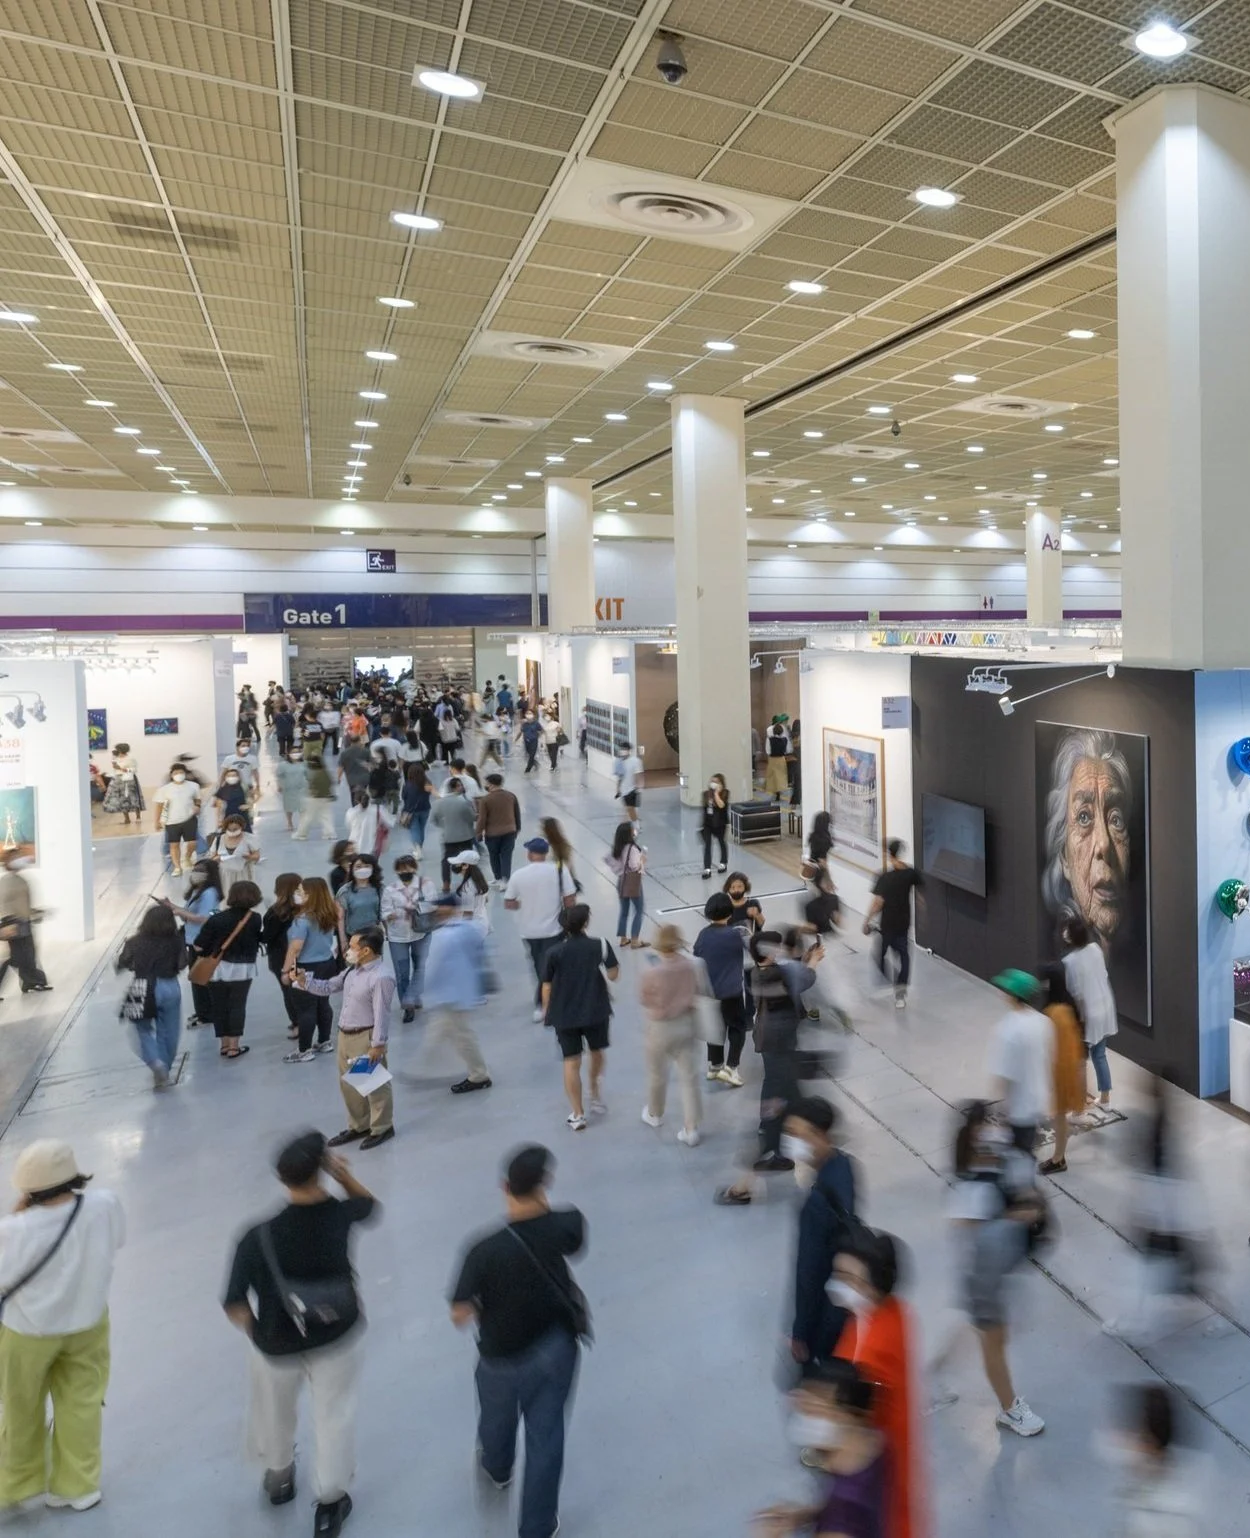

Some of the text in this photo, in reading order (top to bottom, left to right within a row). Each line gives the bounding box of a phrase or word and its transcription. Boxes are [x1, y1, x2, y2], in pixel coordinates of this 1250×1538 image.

[1042, 533, 1060, 551] A2
[283, 603, 347, 625] Gate 1
[595, 598, 625, 621] XIT
